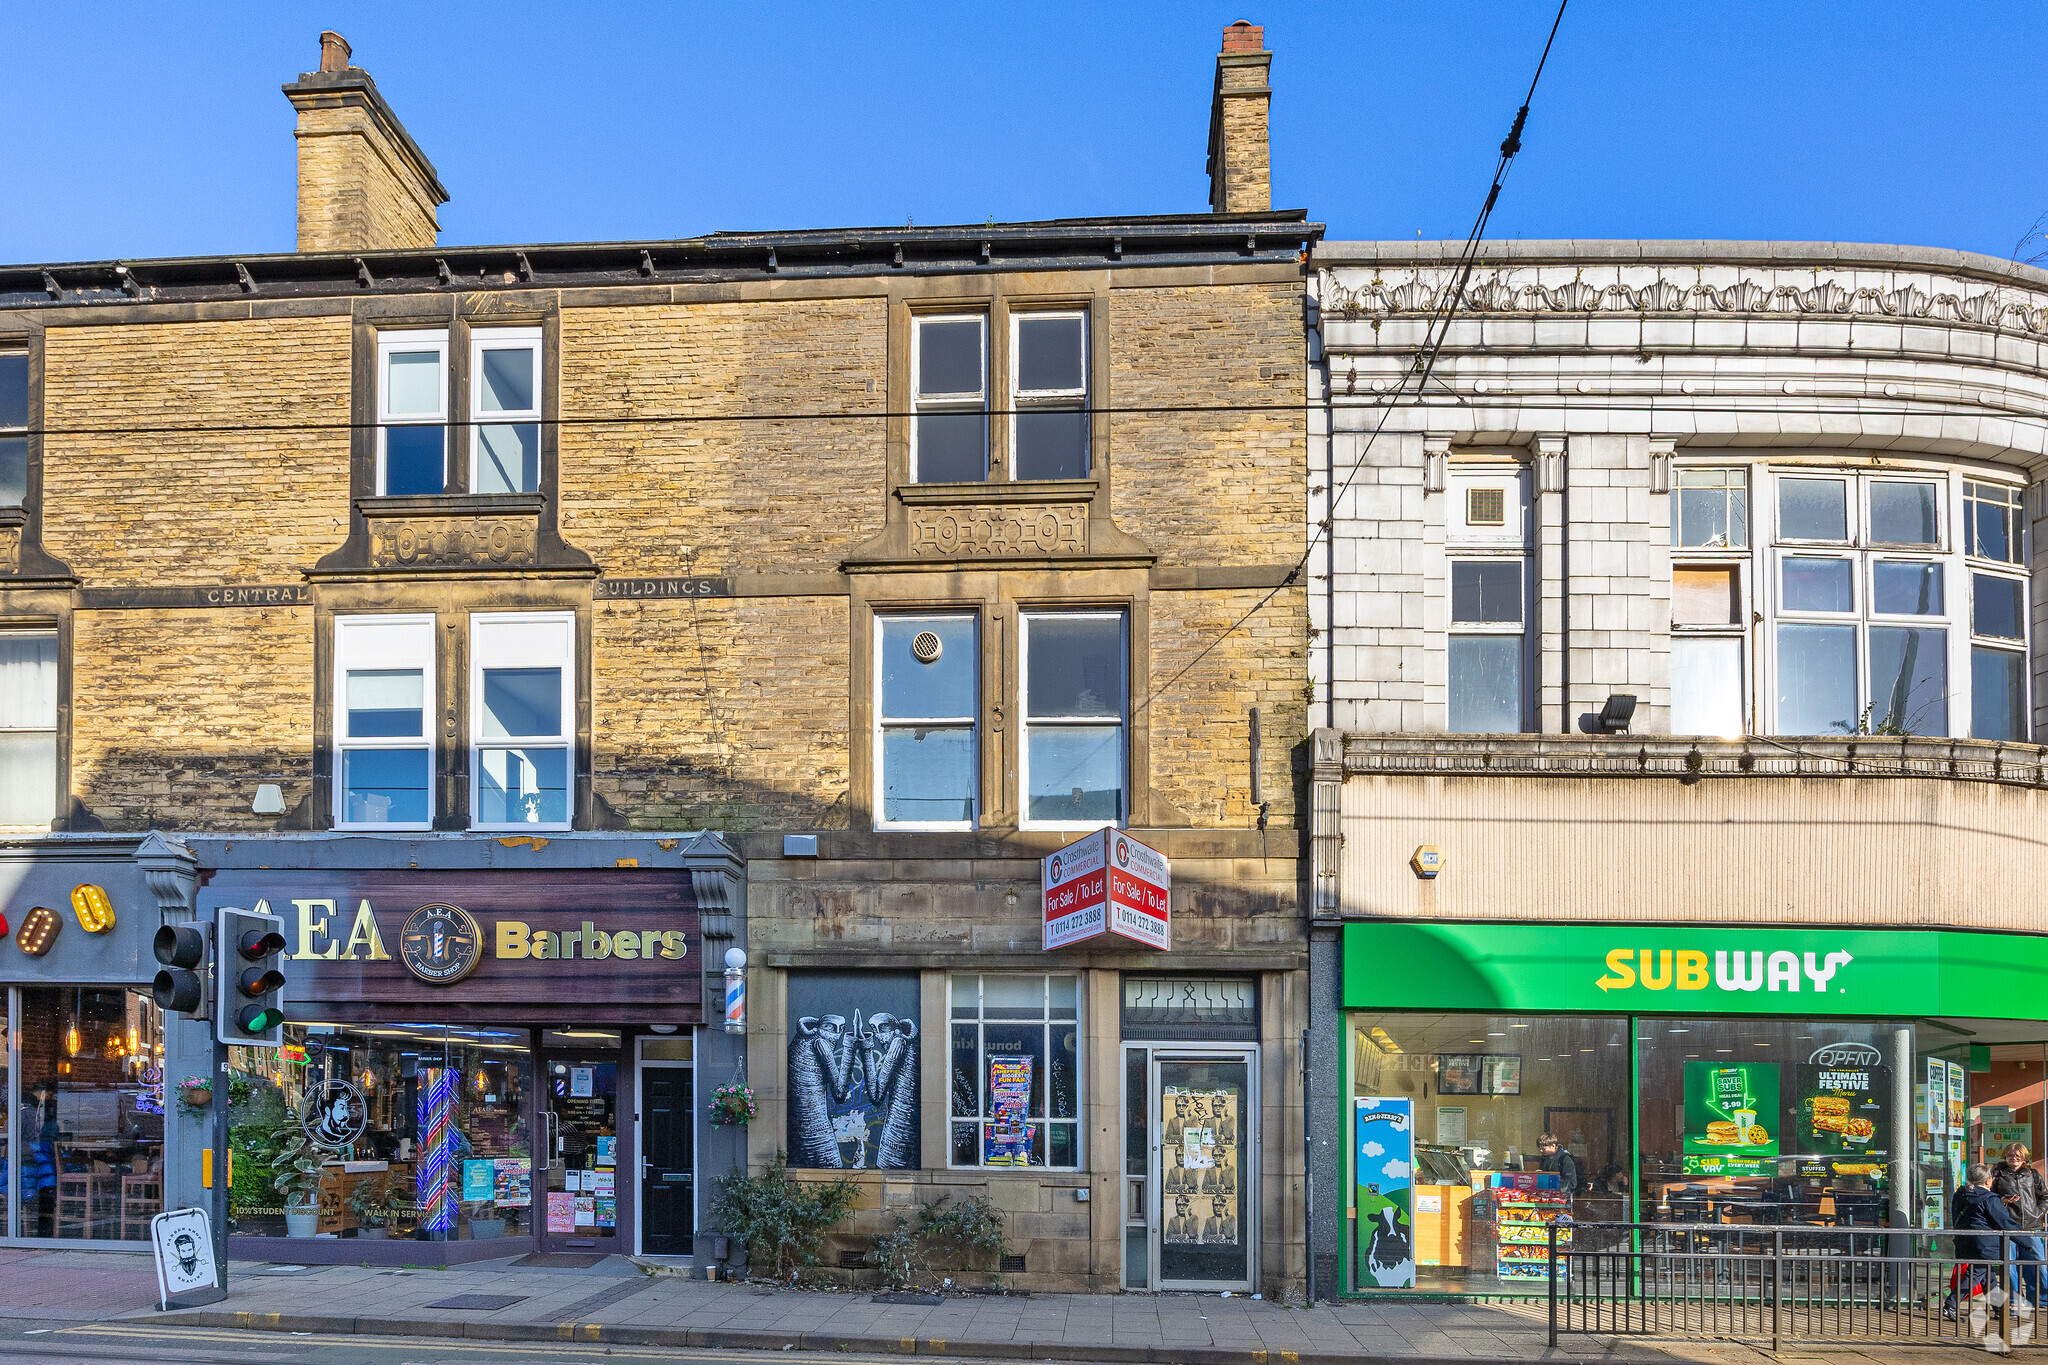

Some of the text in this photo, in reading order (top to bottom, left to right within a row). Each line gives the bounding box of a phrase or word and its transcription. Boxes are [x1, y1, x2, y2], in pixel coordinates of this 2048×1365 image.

[207, 586, 308, 603] CENTRAL
[1063, 841, 1100, 866] Crosthwaite
[1130, 844, 1164, 871] Crosthwaite
[1424, 854, 1438, 862] ADT
[1063, 855, 1100, 878] COMMERCIAL
[1130, 860, 1164, 884] COMMERCIAL
[1048, 896, 1060, 912] For
[1059, 888, 1074, 908] Sale
[1080, 882, 1090, 900] To
[1091, 877, 1104, 897] Let
[1113, 875, 1126, 893] For
[1126, 882, 1141, 902] Sale
[1146, 890, 1155, 908] To
[1156, 894, 1167, 913] Let
[426, 908, 452, 919] A.E.A
[253, 898, 688, 961] EA Barbers
[1050, 908, 1102, 936] T 0114 272 3888
[1116, 907, 1165, 937] T 0114 272 3888
[415, 961, 461, 977] BARBER SHOP
[1595, 948, 1854, 992] SUBWAY
[1818, 1071, 1869, 1081] ULTIMATE
[1717, 1083, 1743, 1092] SUBS
[1818, 1080, 1869, 1090] FESTIVE
[1832, 1086, 1857, 1096] Menu
[1722, 1101, 1741, 1110] 3.99
[1700, 1158, 1720, 1167] SUB
[236, 1207, 252, 1215] 10%
[364, 1209, 388, 1217] WALK
[167, 1227, 186, 1247] BARBER
[178, 1271, 203, 1283] SHAVING
